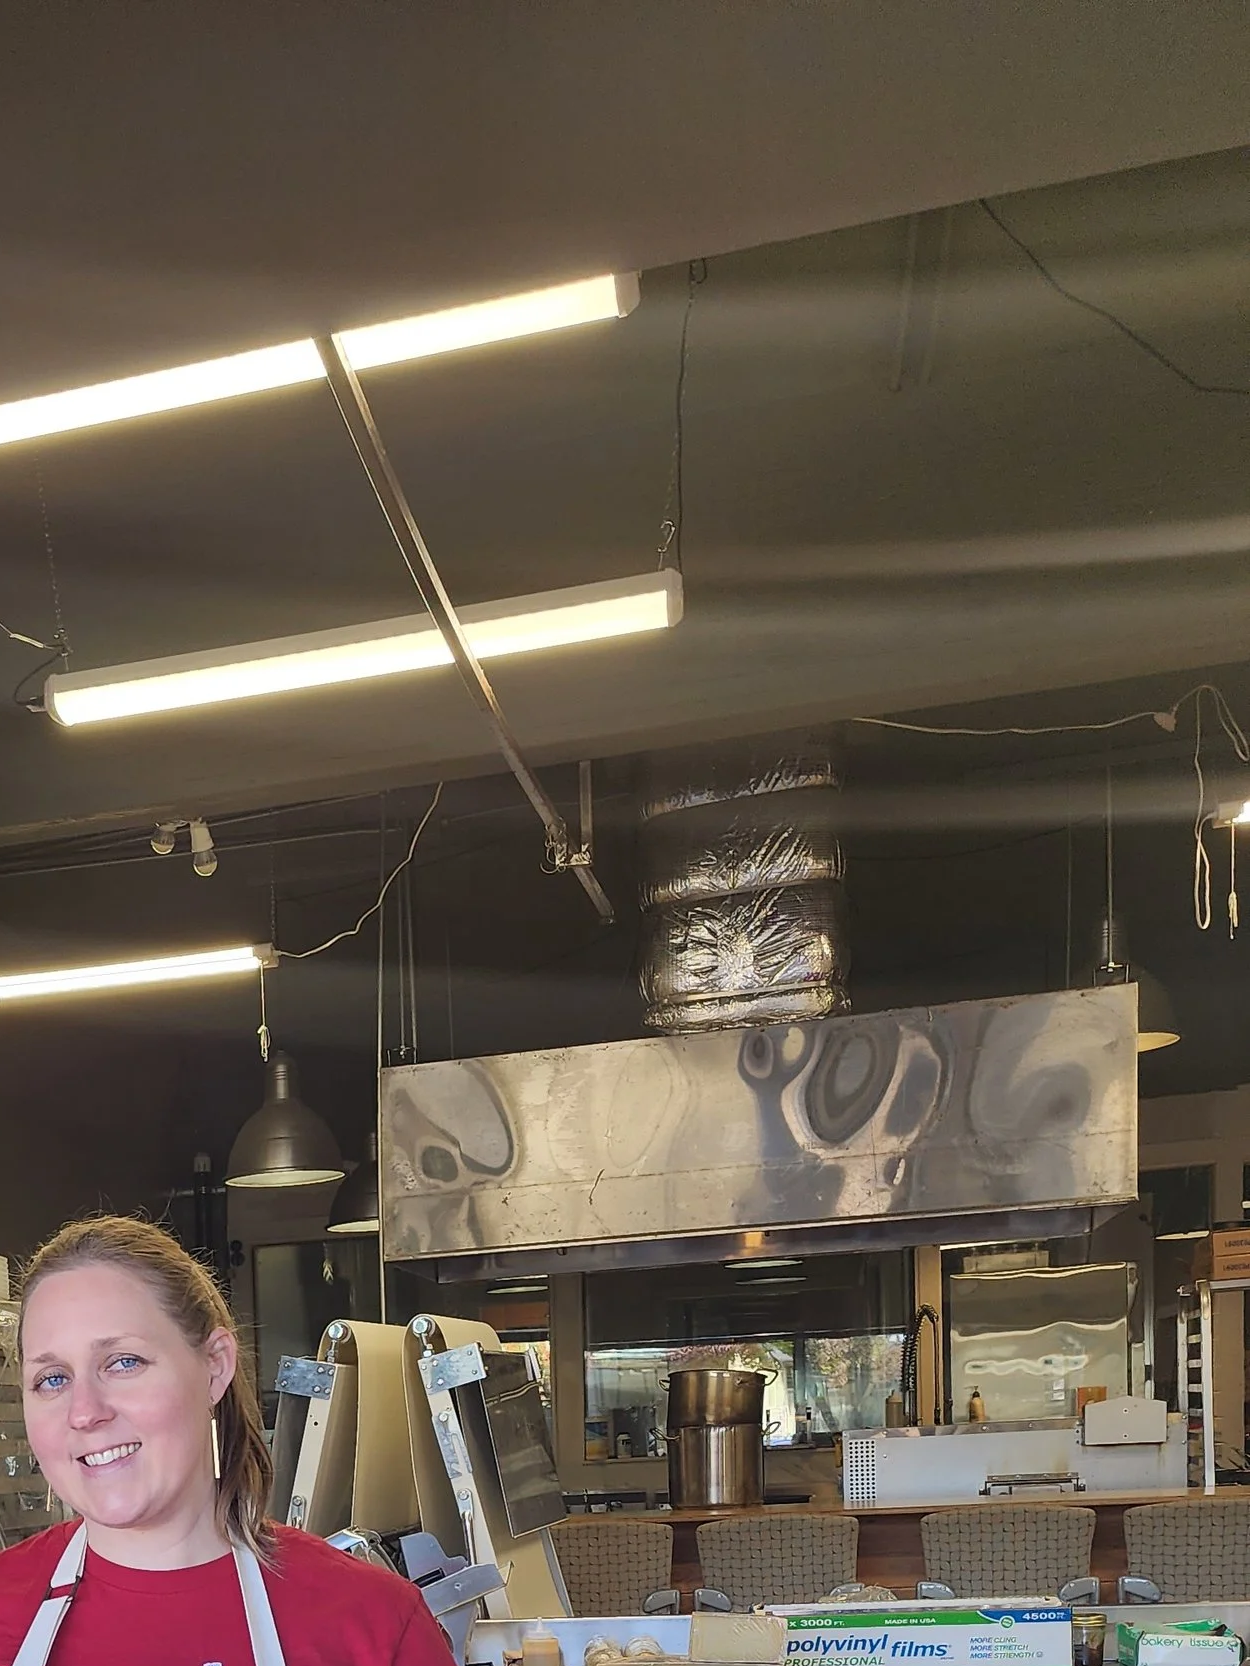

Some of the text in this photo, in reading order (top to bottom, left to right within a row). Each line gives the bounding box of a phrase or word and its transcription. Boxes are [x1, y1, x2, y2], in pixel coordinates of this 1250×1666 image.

[919, 1617, 936, 1625] USA
[1022, 1612, 1056, 1621] 4500
[800, 1618, 832, 1628] 3000
[787, 1634, 947, 1657] polyvinyl films
[1141, 1636, 1224, 1648] bakery tissue
[993, 1651, 1035, 1659] STRENGTH
[784, 1656, 885, 1666] PROFESSIONAL
